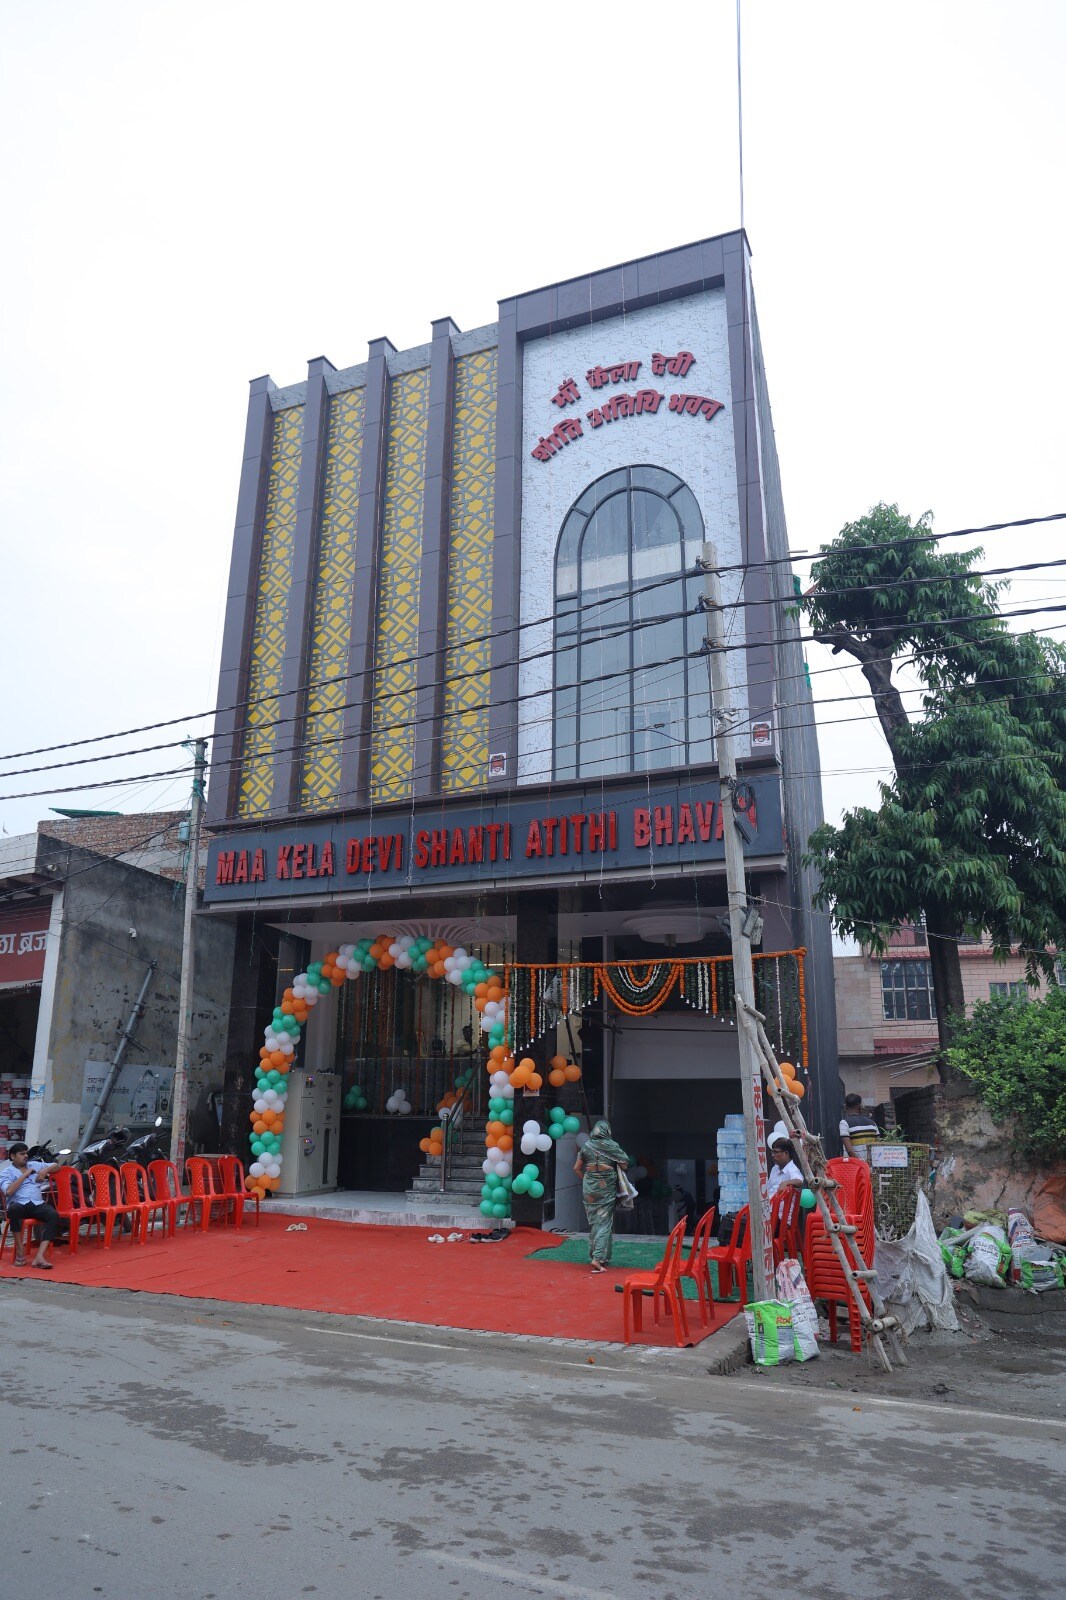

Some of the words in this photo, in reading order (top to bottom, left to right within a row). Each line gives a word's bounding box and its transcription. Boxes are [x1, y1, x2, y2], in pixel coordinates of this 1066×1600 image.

[651, 351, 697, 377] देवी
[530, 418, 585, 462] शांति
[586, 389, 665, 429] अतिथि
[668, 393, 725, 422] भवन
[215, 848, 267, 885] MAA
[276, 840, 335, 879] KELA
[346, 833, 404, 874] DEVI
[415, 822, 512, 868] SHANTI
[525, 811, 617, 858] ATITHI
